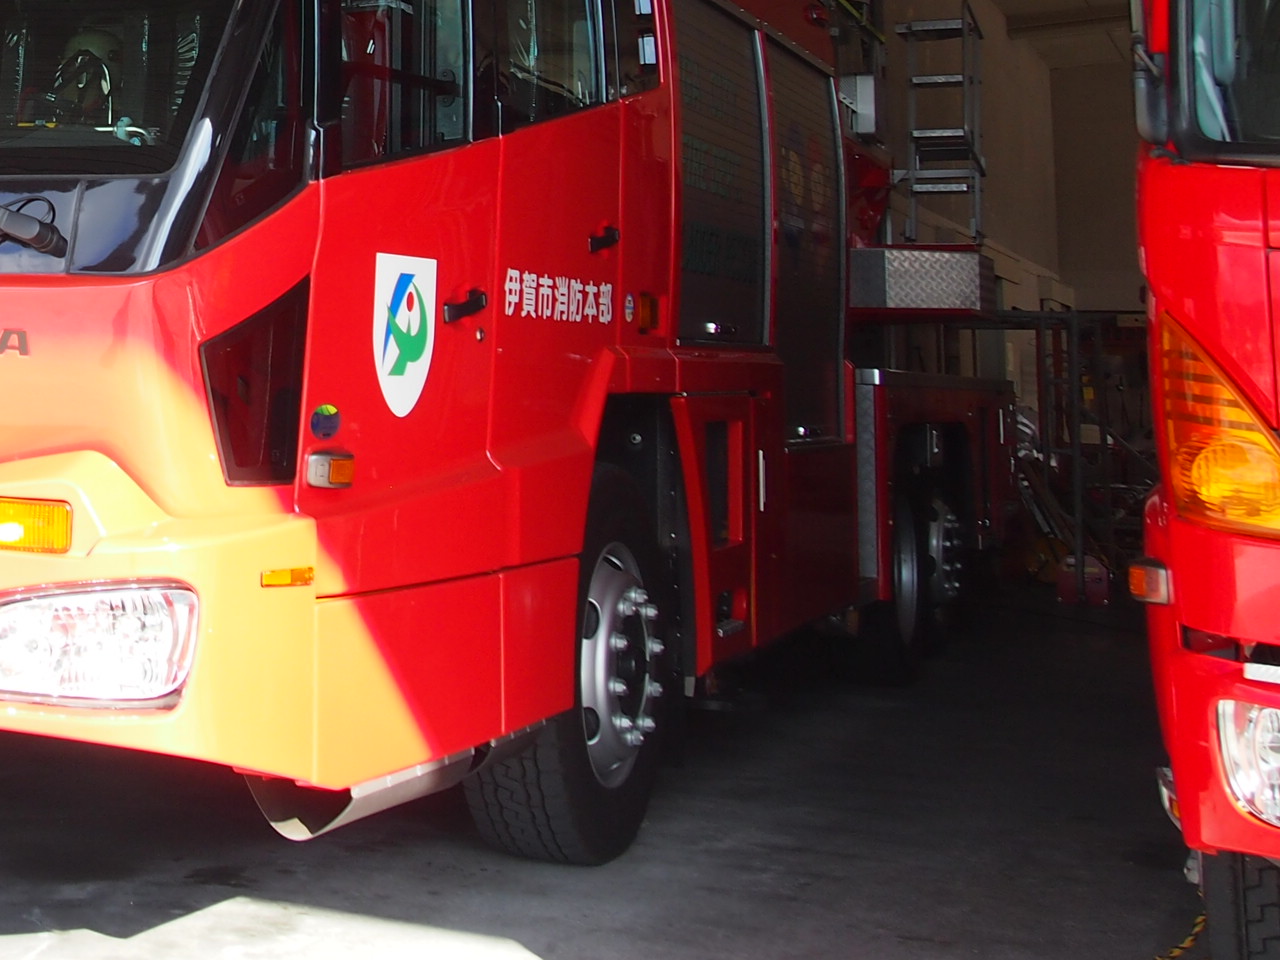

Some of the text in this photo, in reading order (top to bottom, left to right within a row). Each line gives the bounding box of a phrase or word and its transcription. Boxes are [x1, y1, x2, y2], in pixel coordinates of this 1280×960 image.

[504, 267, 613, 325] 伊賀市消防本部
